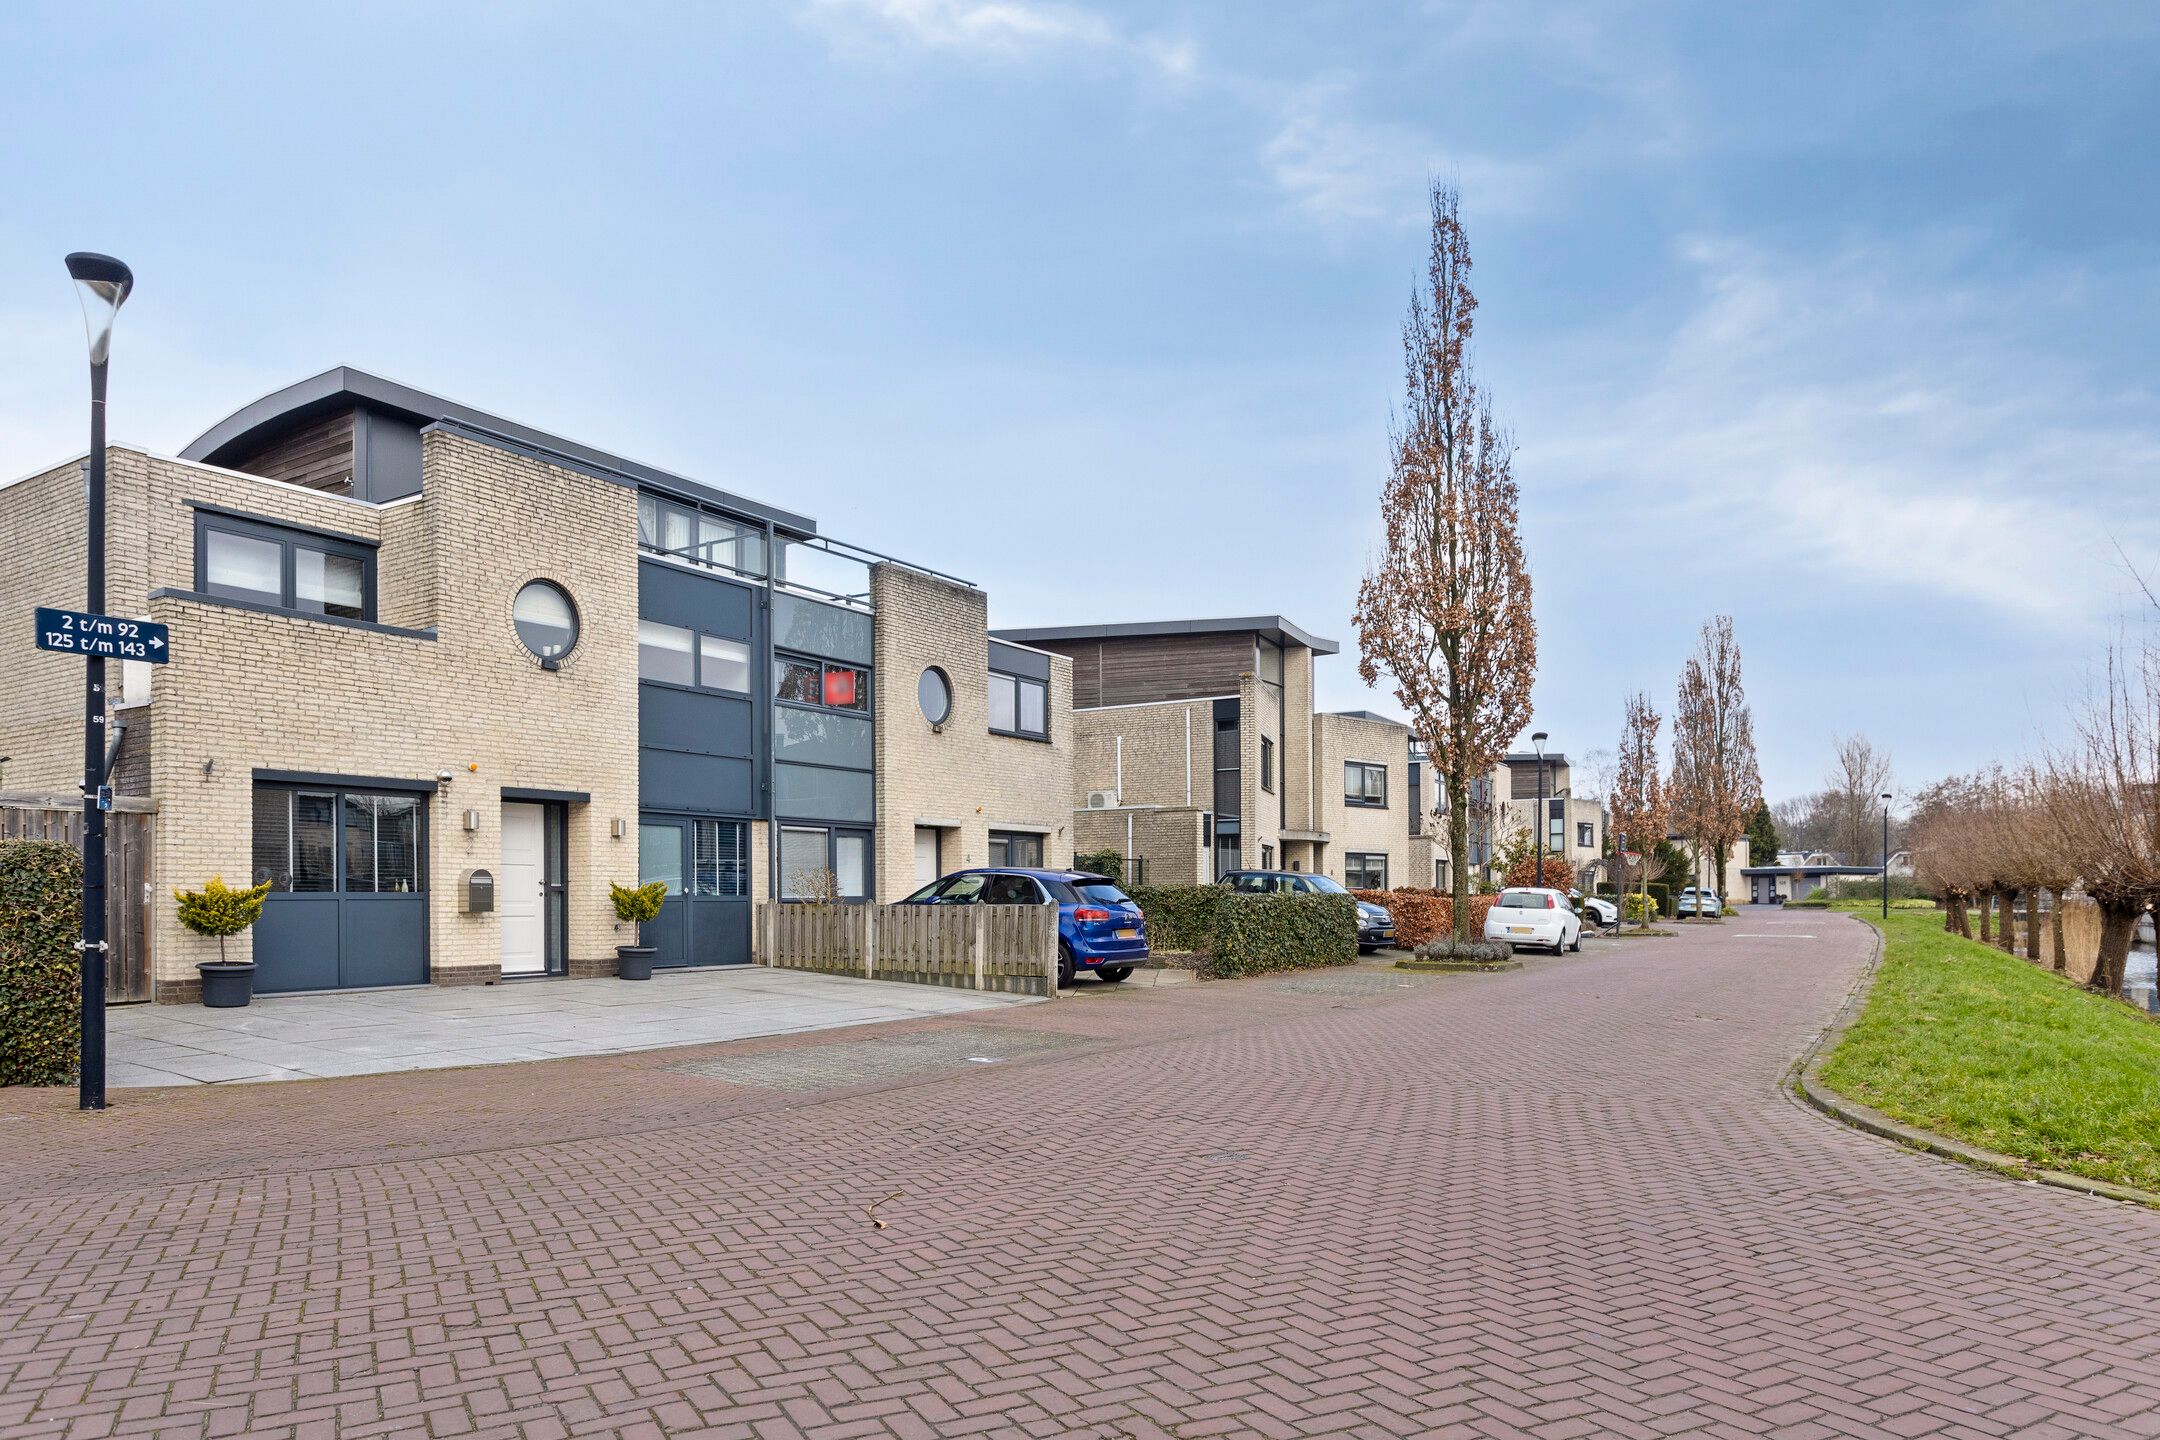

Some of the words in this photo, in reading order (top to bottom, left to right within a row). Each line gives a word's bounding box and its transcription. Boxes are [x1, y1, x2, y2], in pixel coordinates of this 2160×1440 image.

[62, 615, 73, 630] 2
[80, 619, 113, 633] t/m
[118, 623, 139, 638] 92
[46, 632, 74, 648] 125
[80, 638, 113, 653] t/m
[119, 641, 146, 657] 143
[93, 715, 105, 724] 59
